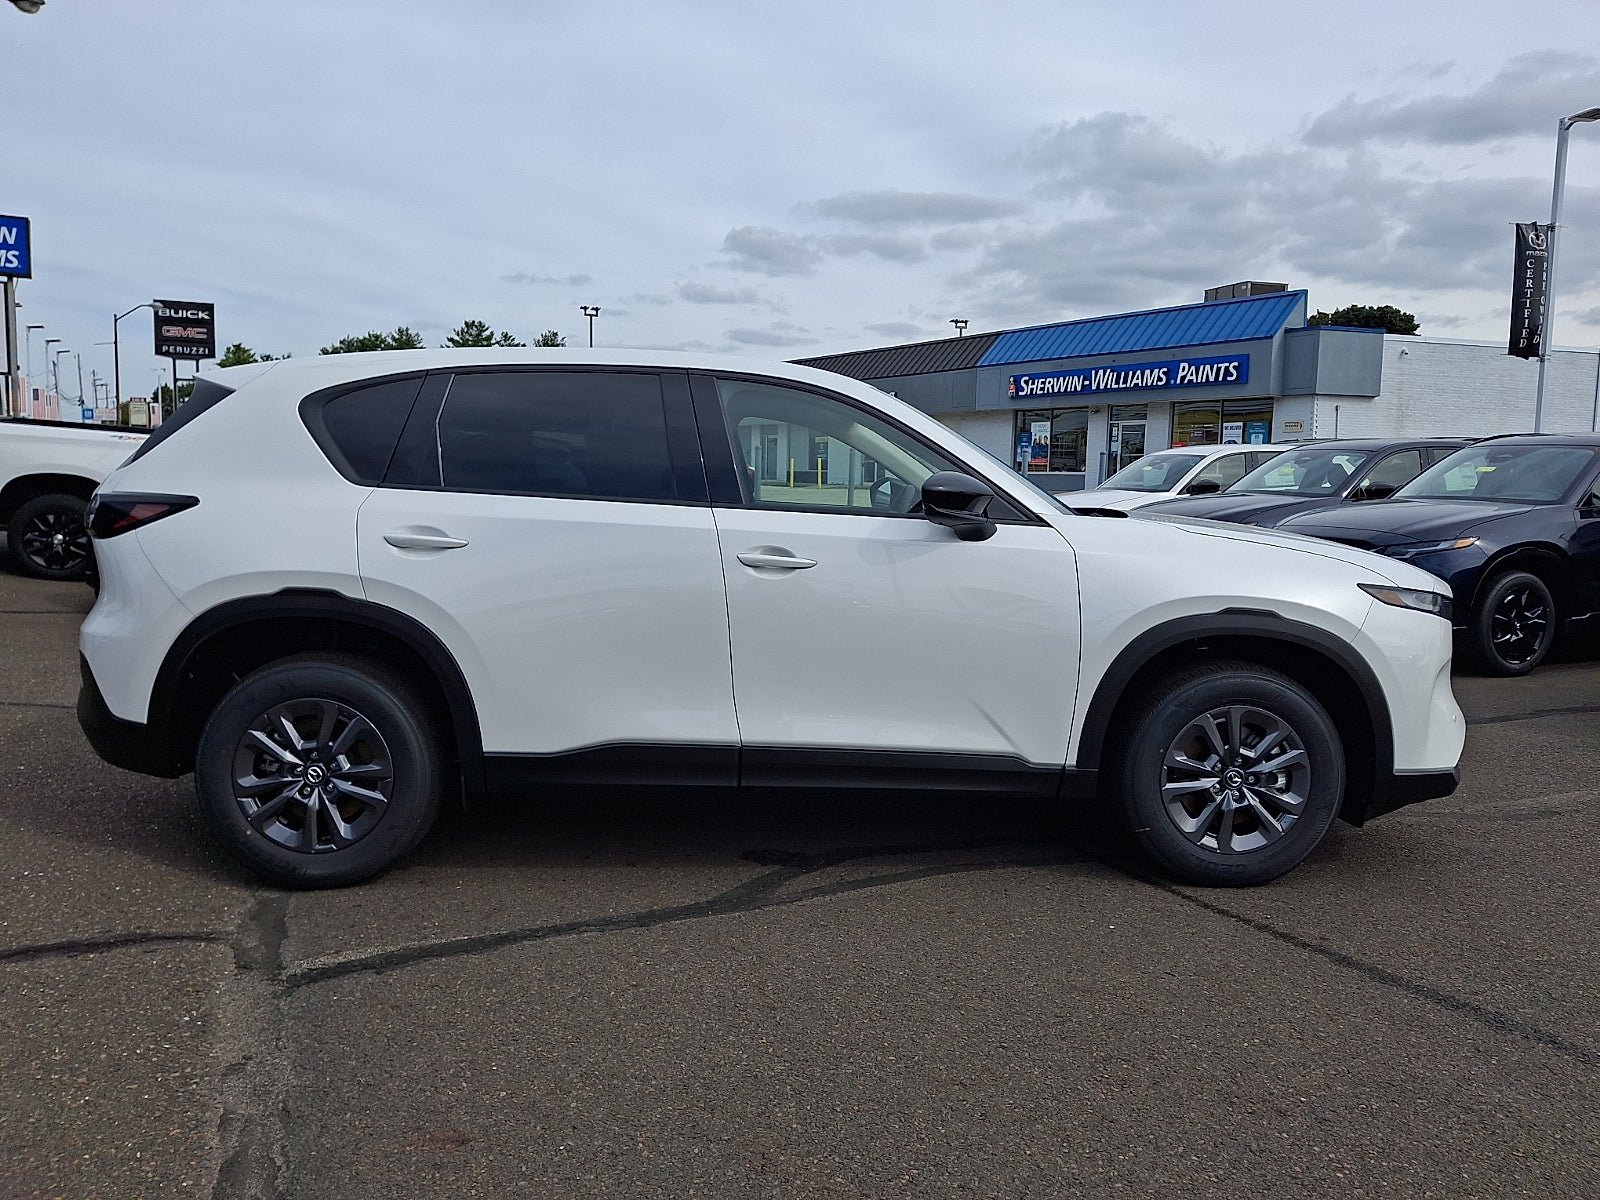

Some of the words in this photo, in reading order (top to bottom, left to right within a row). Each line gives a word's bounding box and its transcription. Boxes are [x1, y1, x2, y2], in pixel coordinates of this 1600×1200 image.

[1519, 259, 1535, 348] CERTIFIED
[158, 307, 211, 320] BUICK
[161, 325, 208, 339] GMC
[162, 344, 209, 355] PERUZZI
[1018, 368, 1168, 396] SHERWIN-WILLIAMS
[1176, 361, 1239, 385] PAINTS
